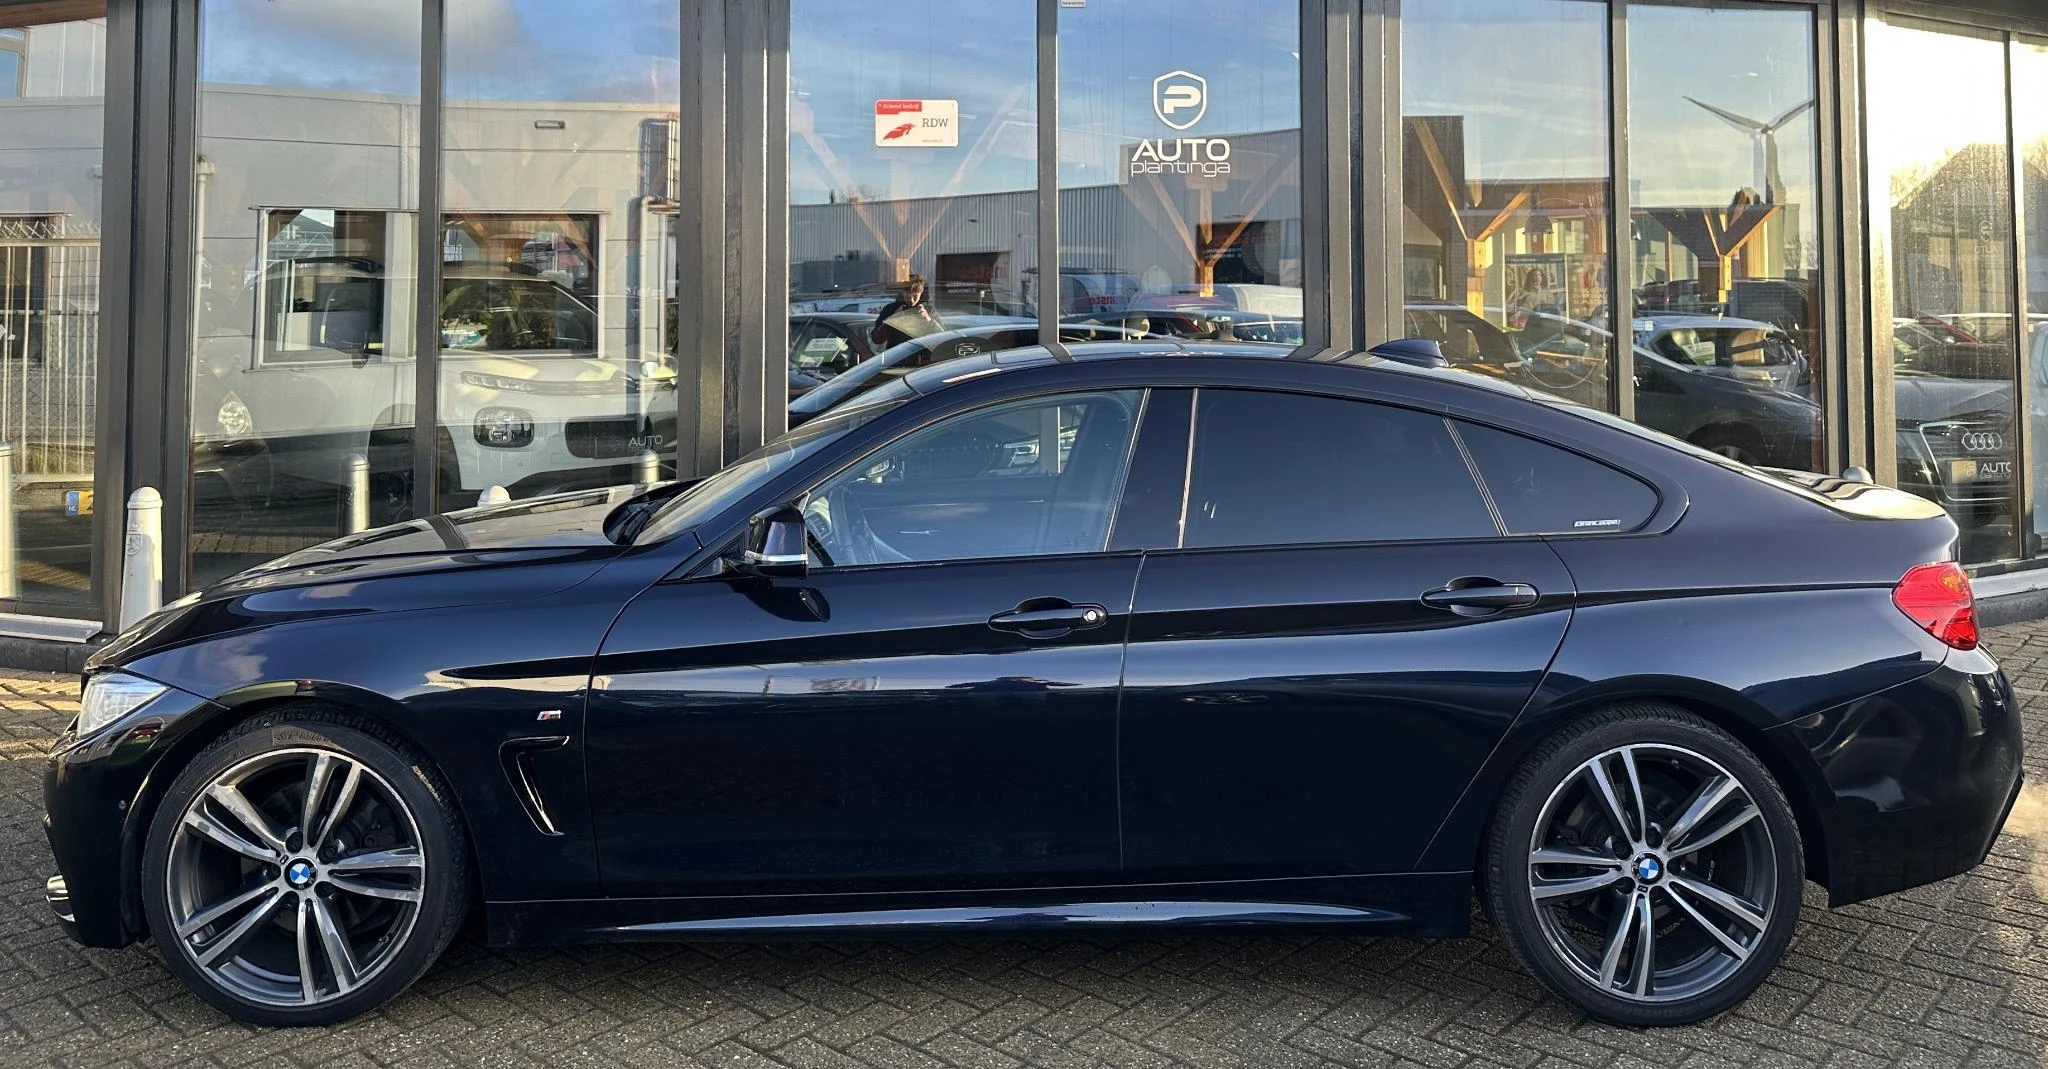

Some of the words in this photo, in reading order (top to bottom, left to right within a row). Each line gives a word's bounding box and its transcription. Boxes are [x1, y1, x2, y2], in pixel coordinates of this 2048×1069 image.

[921, 117, 949, 128] RDW
[1131, 138, 1231, 161] AUTO
[1131, 160, 1231, 179] plantinga
[628, 434, 663, 447] AUTO
